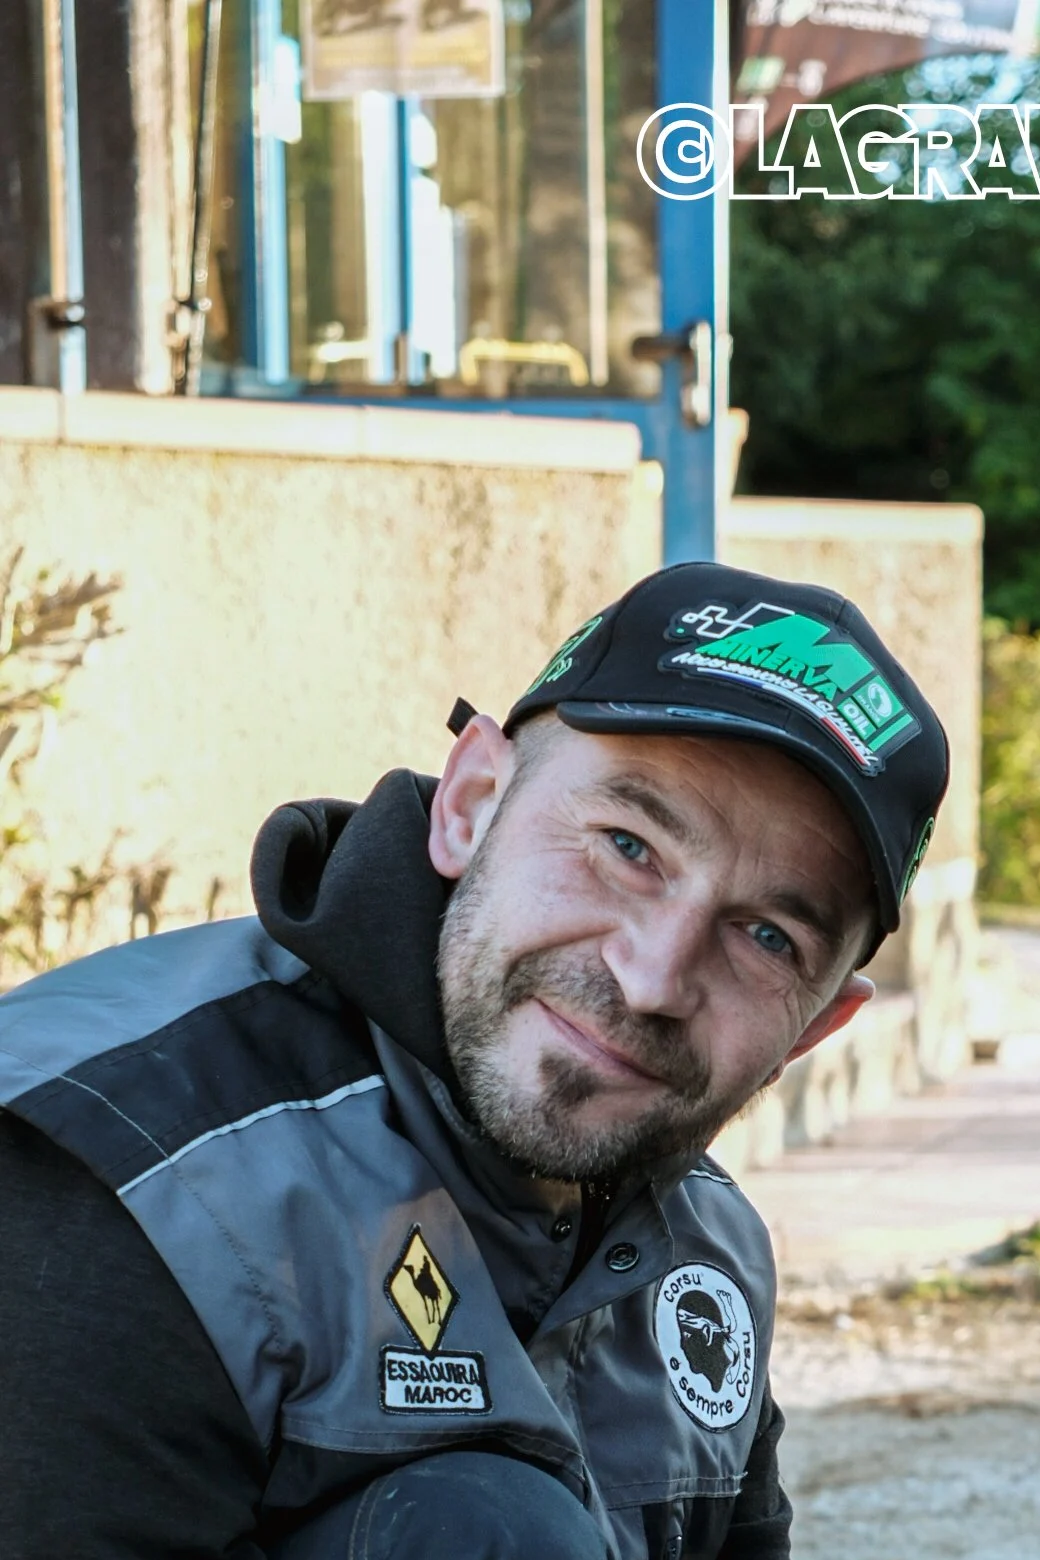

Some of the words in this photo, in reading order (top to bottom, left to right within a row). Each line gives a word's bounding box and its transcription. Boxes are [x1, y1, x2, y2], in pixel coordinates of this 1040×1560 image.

[695, 638, 838, 701] MINERVA
[842, 702, 870, 739] OIL
[386, 1357, 481, 1387] ESSAOUIRA
[404, 1383, 473, 1405] MAROC
